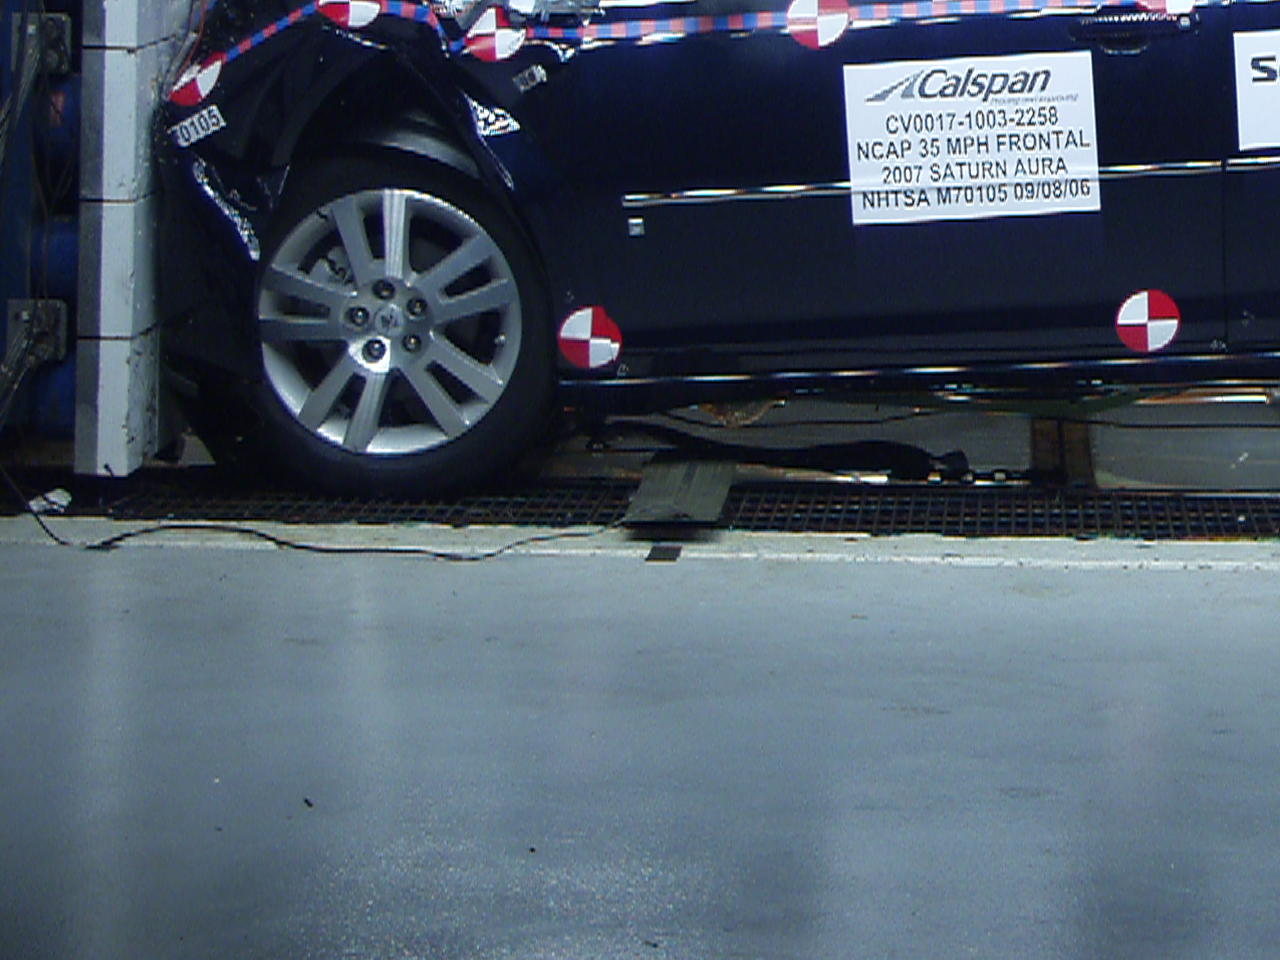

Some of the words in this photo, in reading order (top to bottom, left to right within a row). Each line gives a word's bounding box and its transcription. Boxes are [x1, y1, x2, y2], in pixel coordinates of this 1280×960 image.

[918, 67, 1051, 102] Calspan
[886, 106, 1060, 135] CV0017-1003-2258
[857, 140, 912, 161] NCAP
[919, 139, 940, 157] 35
[947, 136, 990, 156] MPH
[996, 129, 1091, 153] FRONTAL
[882, 165, 923, 185] 2007
[930, 160, 1007, 182] SATURN
[1014, 157, 1069, 176] AURA
[862, 188, 931, 210] NHTSA
[937, 183, 1009, 205] M70105
[1014, 179, 1091, 200] 09/08/06
